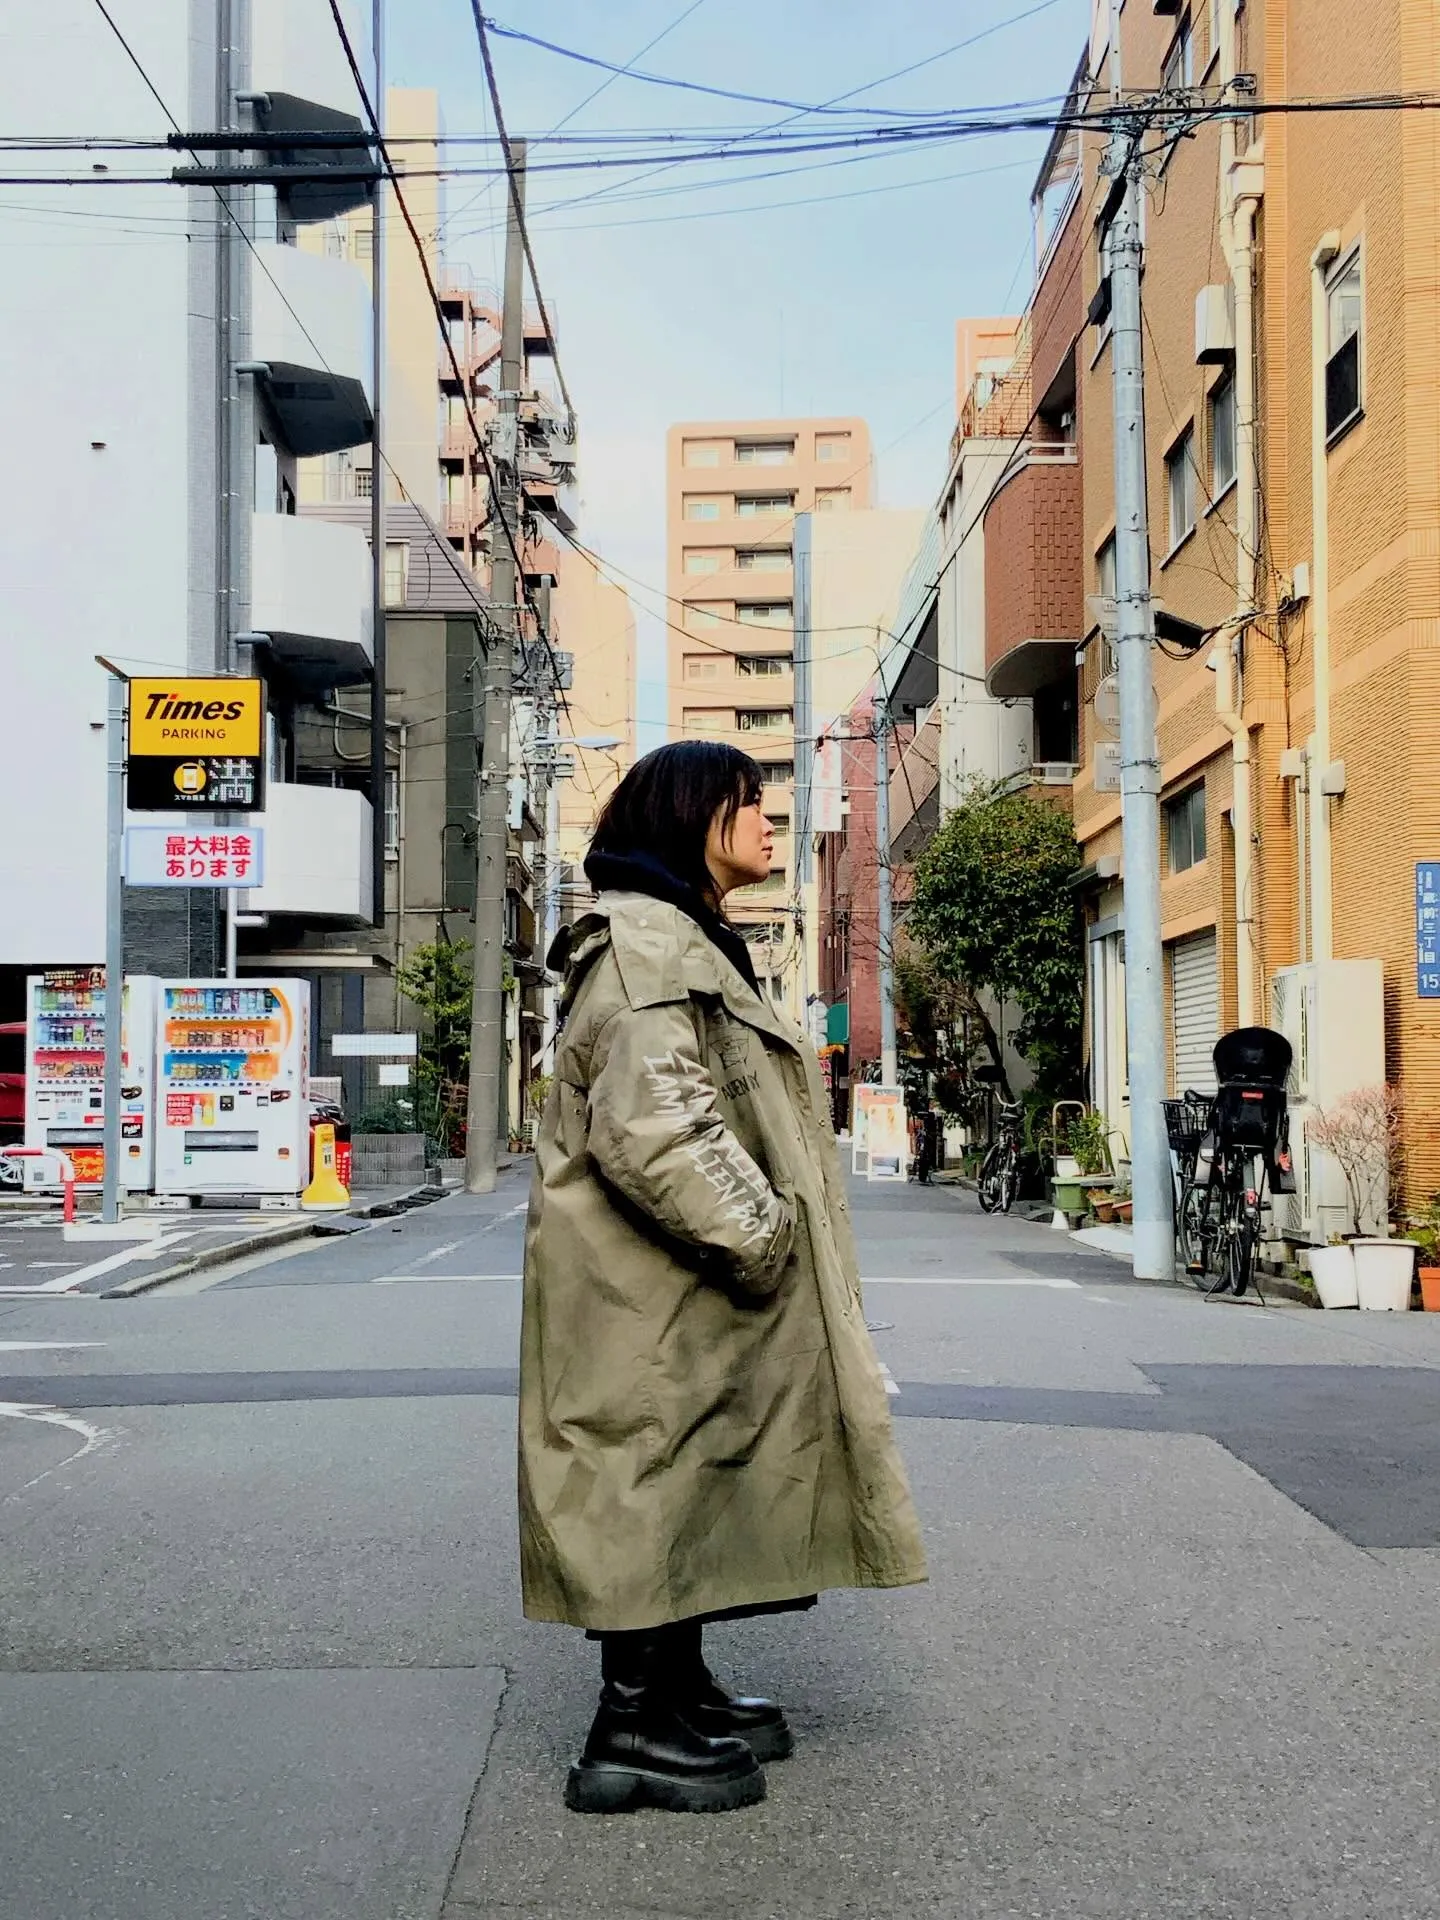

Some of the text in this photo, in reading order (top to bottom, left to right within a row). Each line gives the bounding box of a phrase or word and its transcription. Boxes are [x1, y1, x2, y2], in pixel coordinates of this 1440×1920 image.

[145, 694, 245, 720] Times
[162, 729, 226, 739] PARKING
[209, 758, 255, 804] 満
[166, 836, 251, 856] 最大料金
[166, 859, 251, 878] あります
[1421, 974, 1439, 989] 15
[643, 1050, 677, 1074] I
[644, 1073, 686, 1115] AM
[672, 1136, 748, 1208] ALIEN
[723, 1200, 773, 1249] BOY
